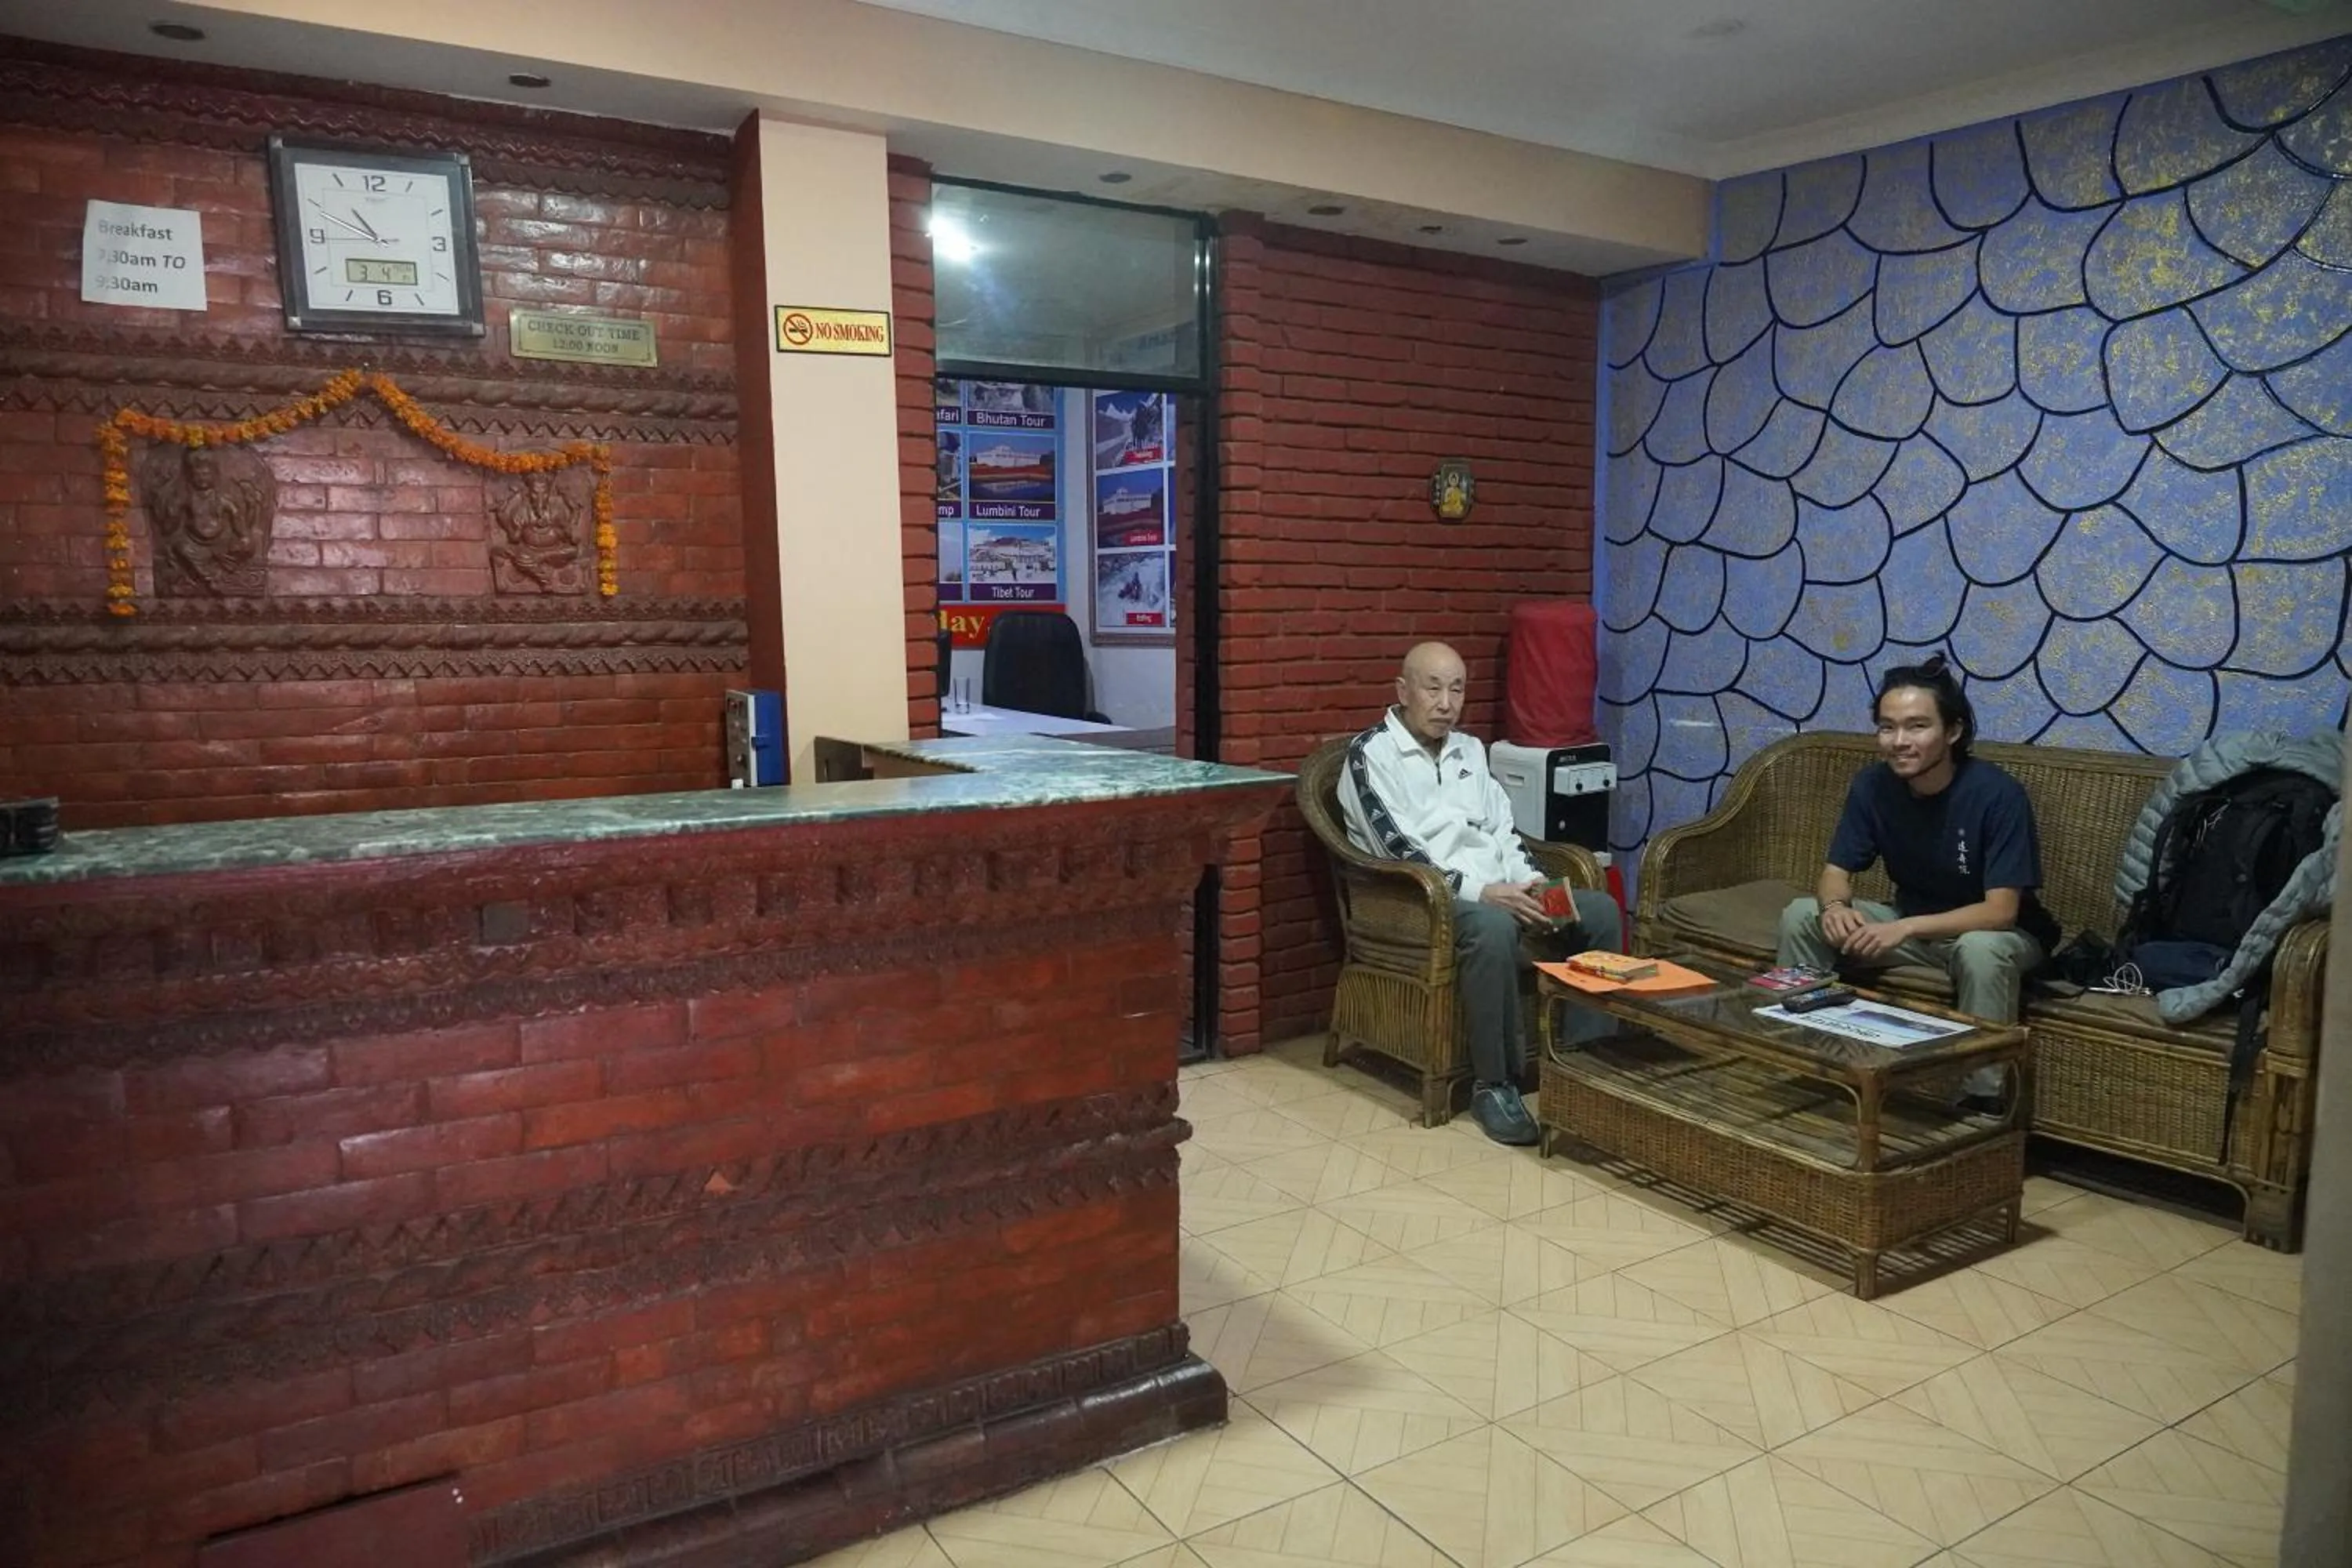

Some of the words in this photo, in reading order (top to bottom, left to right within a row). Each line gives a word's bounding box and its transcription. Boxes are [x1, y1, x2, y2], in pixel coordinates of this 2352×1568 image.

[362, 175, 387, 192] 12
[99, 220, 173, 241] Breakfast
[310, 228, 325, 244] 9
[432, 236, 447, 252] 3
[162, 255, 186, 269] TO
[376, 289, 392, 305] 6
[528, 320, 574, 336] CHECK
[578, 325, 605, 338] OUT
[608, 328, 641, 340] TIME
[815, 322, 832, 339] NO
[833, 323, 884, 343] SMOKING
[976, 412, 1017, 425] Bhutan
[1020, 415, 1045, 427] Tour
[976, 504, 1017, 517] Lumbini
[1018, 506, 1041, 517] Tour
[992, 586, 1014, 598] Tibet
[1015, 587, 1035, 598] Tour
